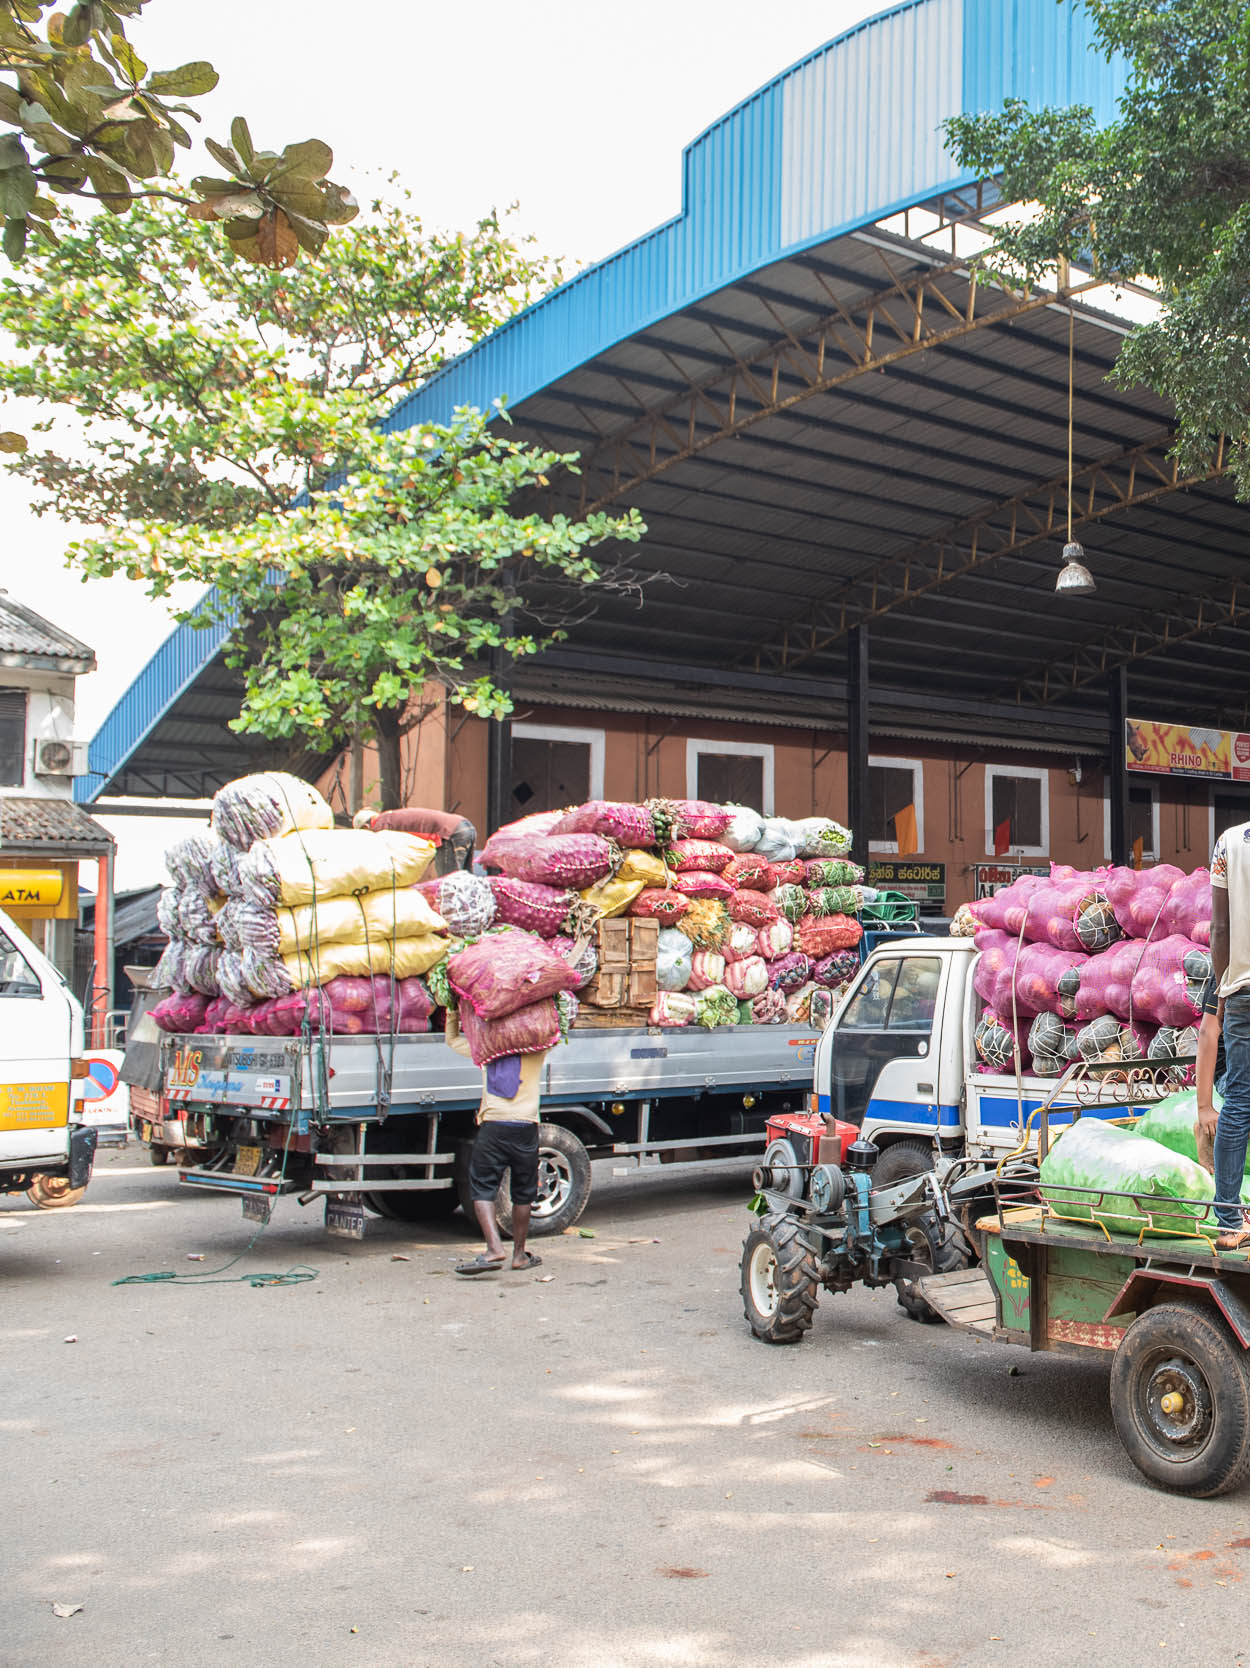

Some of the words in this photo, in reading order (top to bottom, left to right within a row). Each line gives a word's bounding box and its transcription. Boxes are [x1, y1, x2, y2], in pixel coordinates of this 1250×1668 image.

[1170, 752, 1202, 767] RHINO
[1, 889, 40, 901] ATM
[169, 1049, 203, 1087] MS
